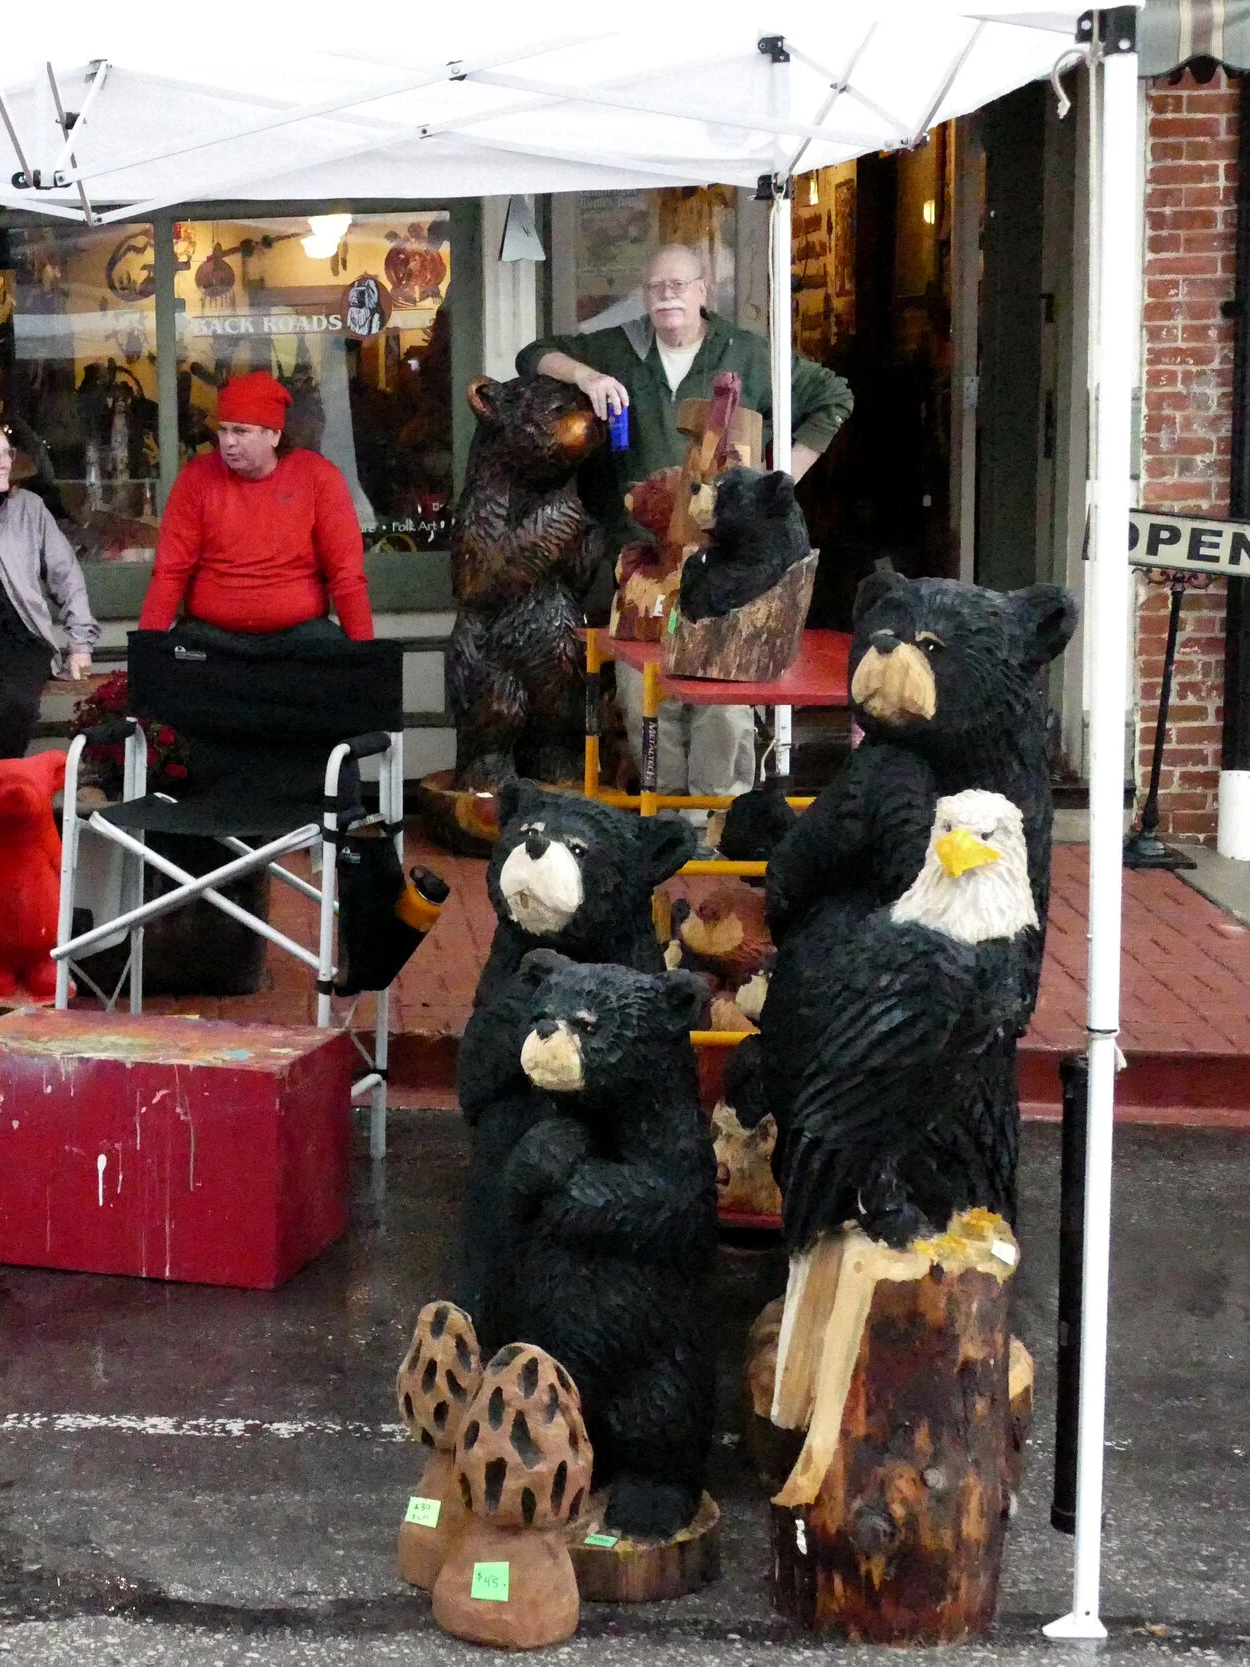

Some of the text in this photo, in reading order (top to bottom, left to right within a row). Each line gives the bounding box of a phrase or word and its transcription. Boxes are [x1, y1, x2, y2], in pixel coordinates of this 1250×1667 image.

[194, 317, 255, 335] BACK
[262, 314, 343, 333] ROADS
[418, 521, 438, 531] Art
[645, 722, 657, 780] METALTECH
